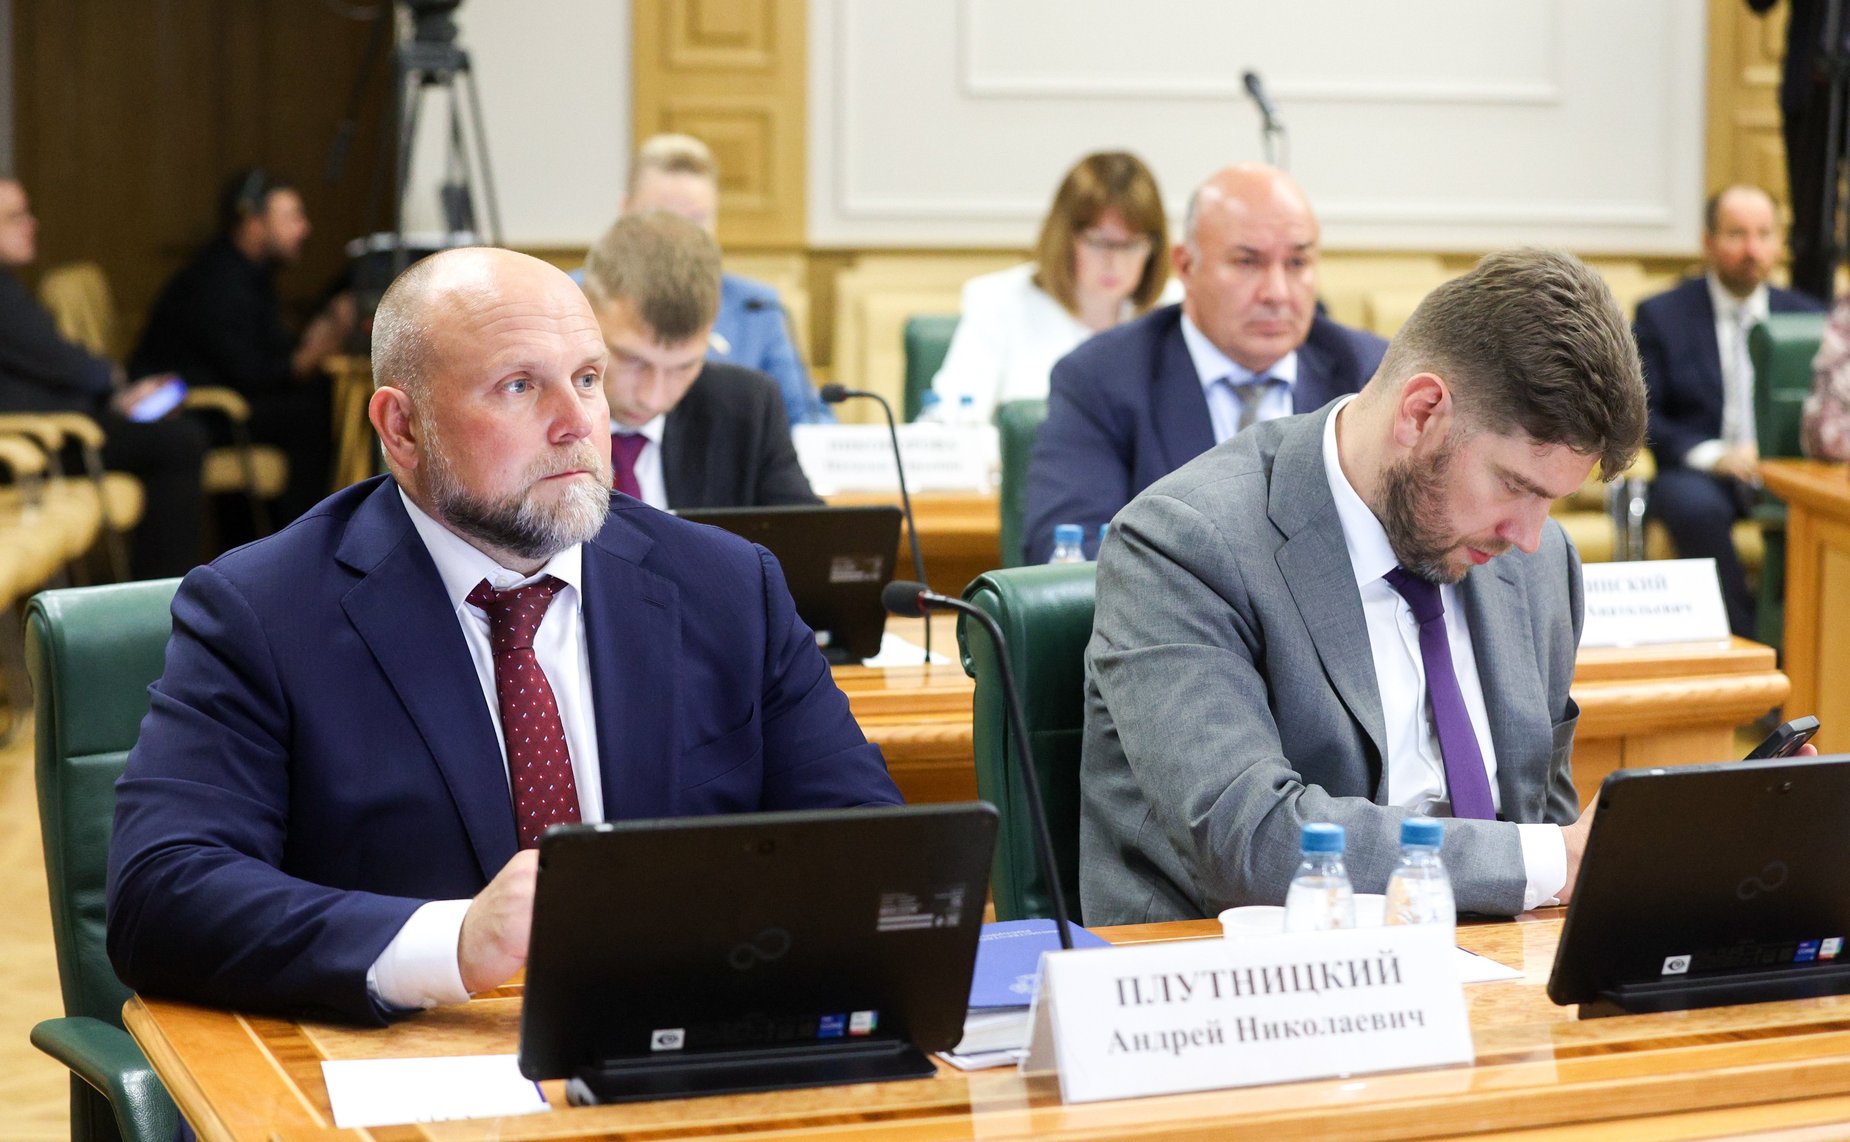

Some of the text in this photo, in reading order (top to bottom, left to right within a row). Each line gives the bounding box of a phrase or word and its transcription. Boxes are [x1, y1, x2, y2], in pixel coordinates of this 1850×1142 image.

[1115, 949, 1404, 1006] ПЛУТНИЦКИЙ
[1108, 1009, 1426, 1057] Андрей Николаевич
